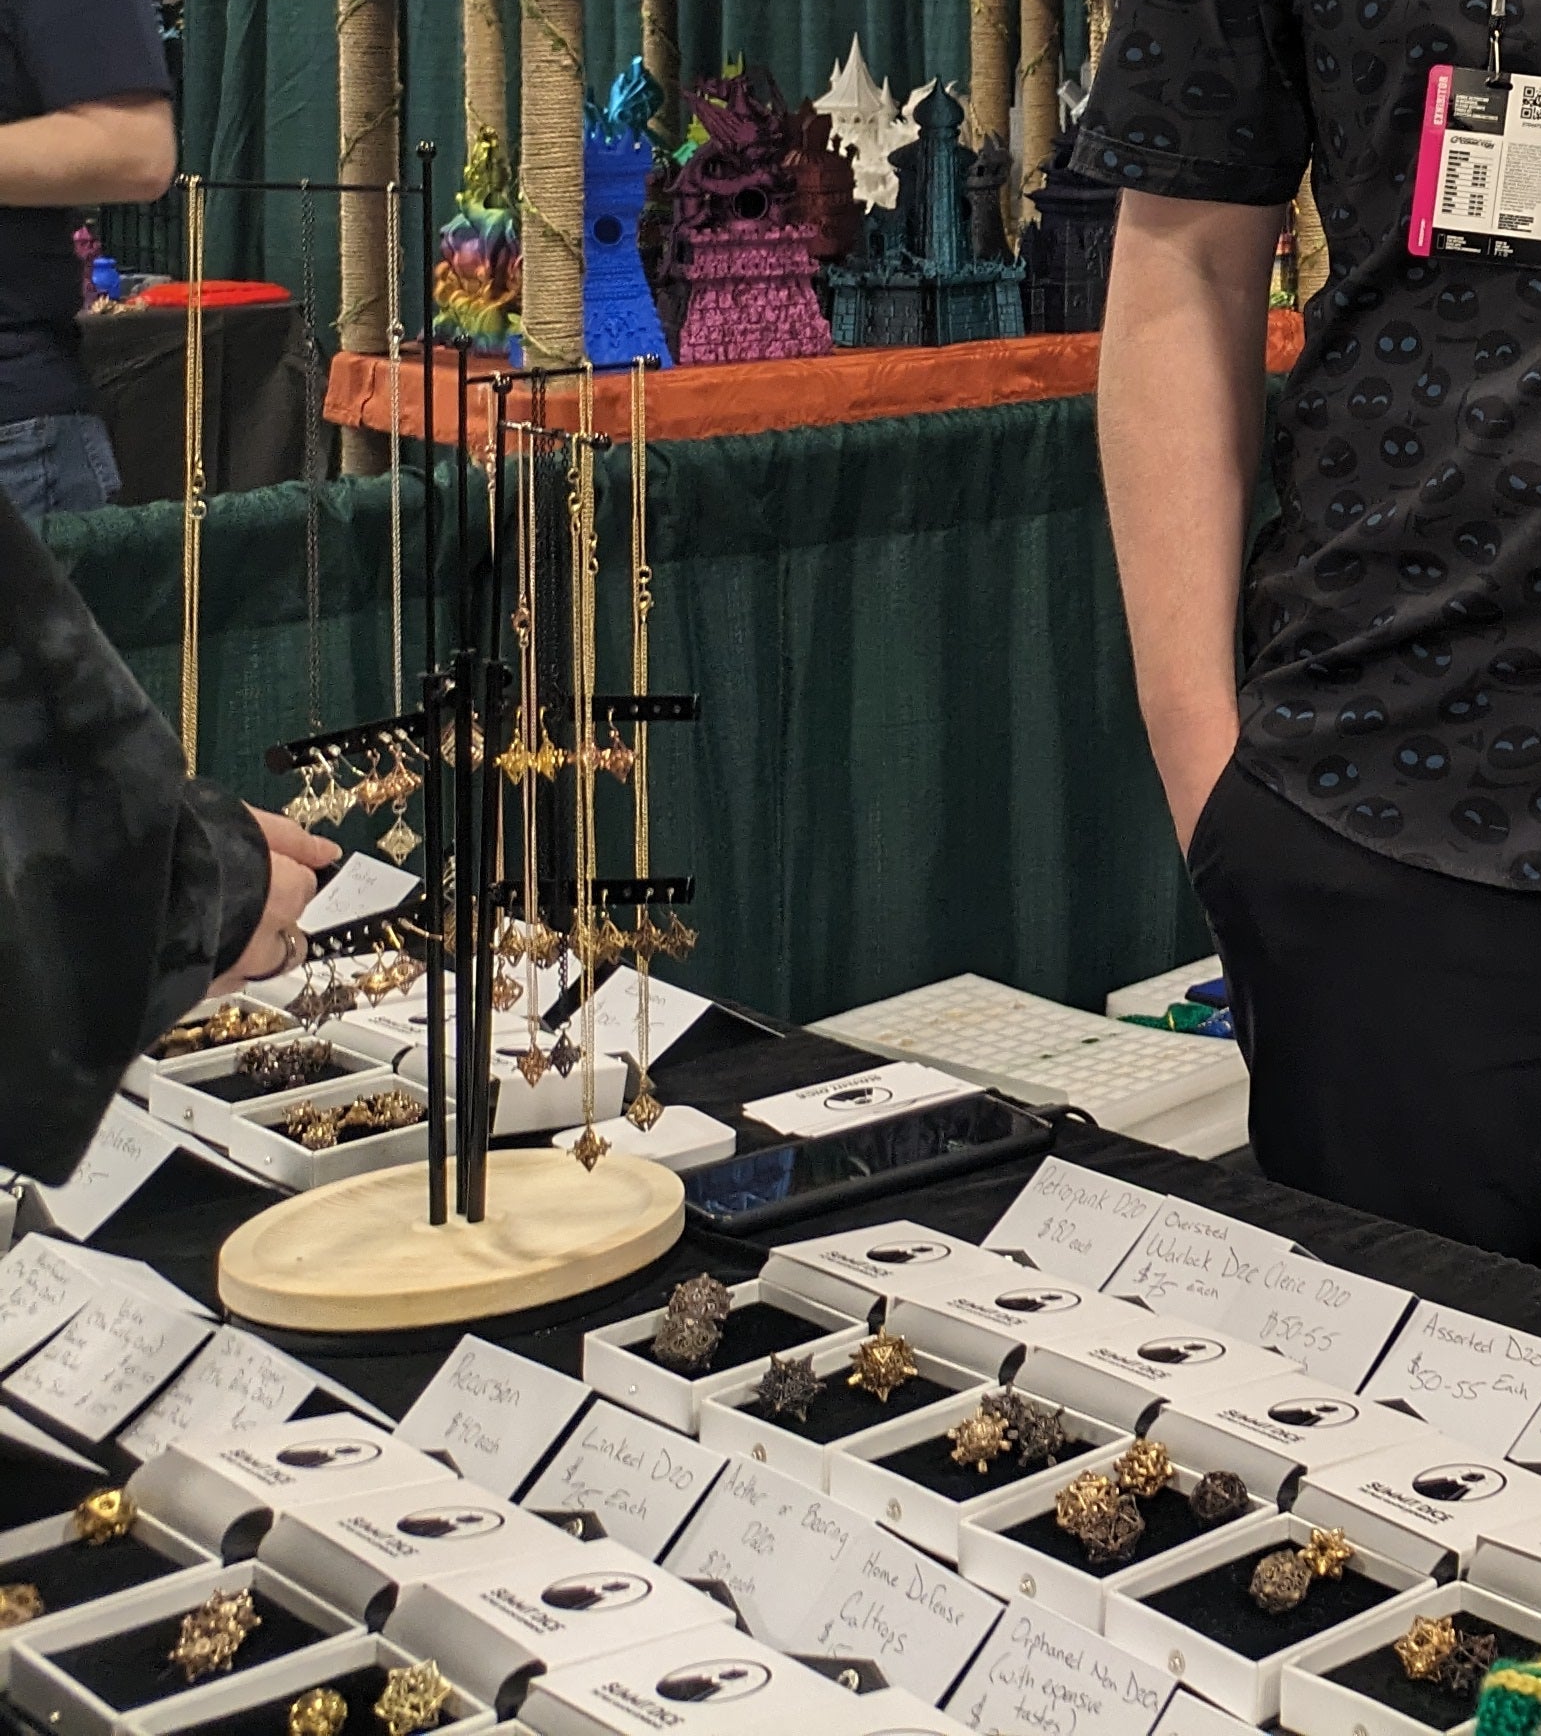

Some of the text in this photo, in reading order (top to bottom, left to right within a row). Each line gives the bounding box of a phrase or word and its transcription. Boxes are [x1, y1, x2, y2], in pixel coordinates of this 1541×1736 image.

[1423, 1312, 1493, 1354] Assorted
[581, 1425, 694, 1491] Linked D20
[604, 1489, 648, 1521] Each
[863, 1552, 965, 1627] Home Defense
[839, 1590, 907, 1656] Caltrops
[1011, 1617, 1085, 1672] Orphaned
